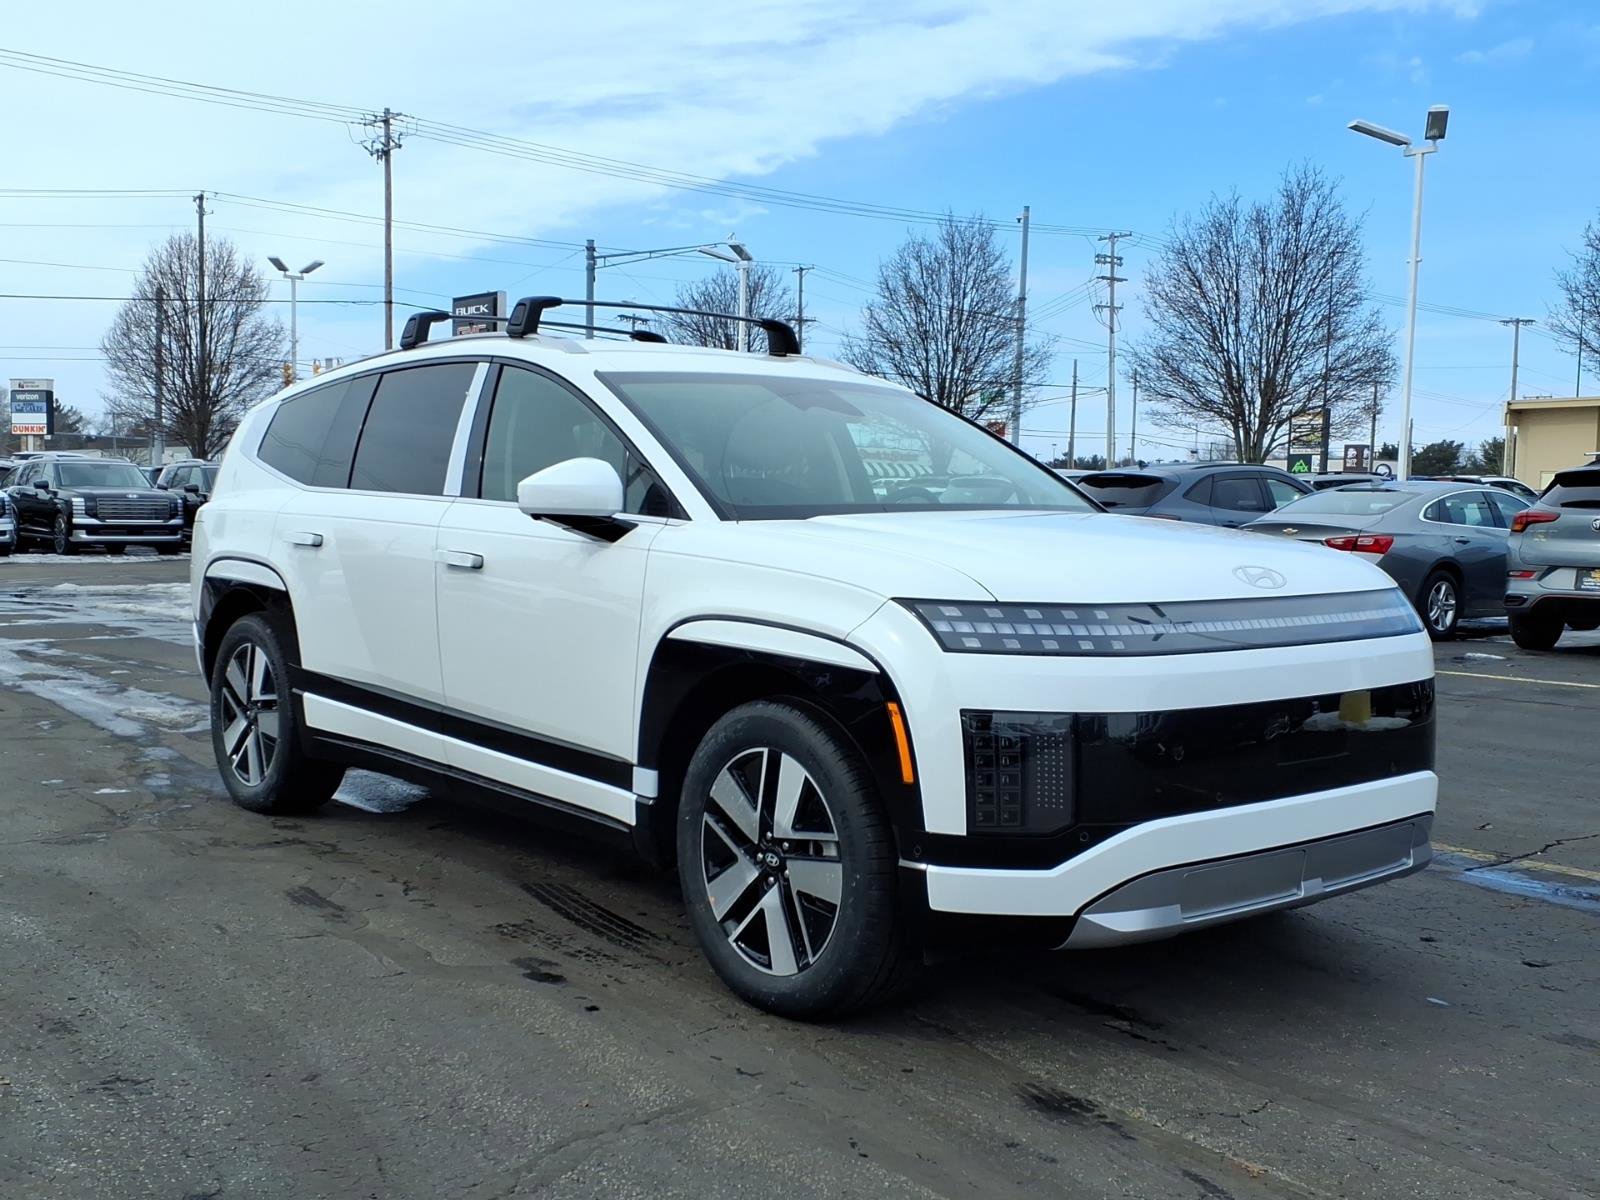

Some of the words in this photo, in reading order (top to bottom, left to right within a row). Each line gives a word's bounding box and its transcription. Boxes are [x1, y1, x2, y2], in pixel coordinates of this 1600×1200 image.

[456, 304, 488, 315] BUICK
[16, 392, 39, 400] verizon
[13, 425, 46, 433] DUNKIN'
